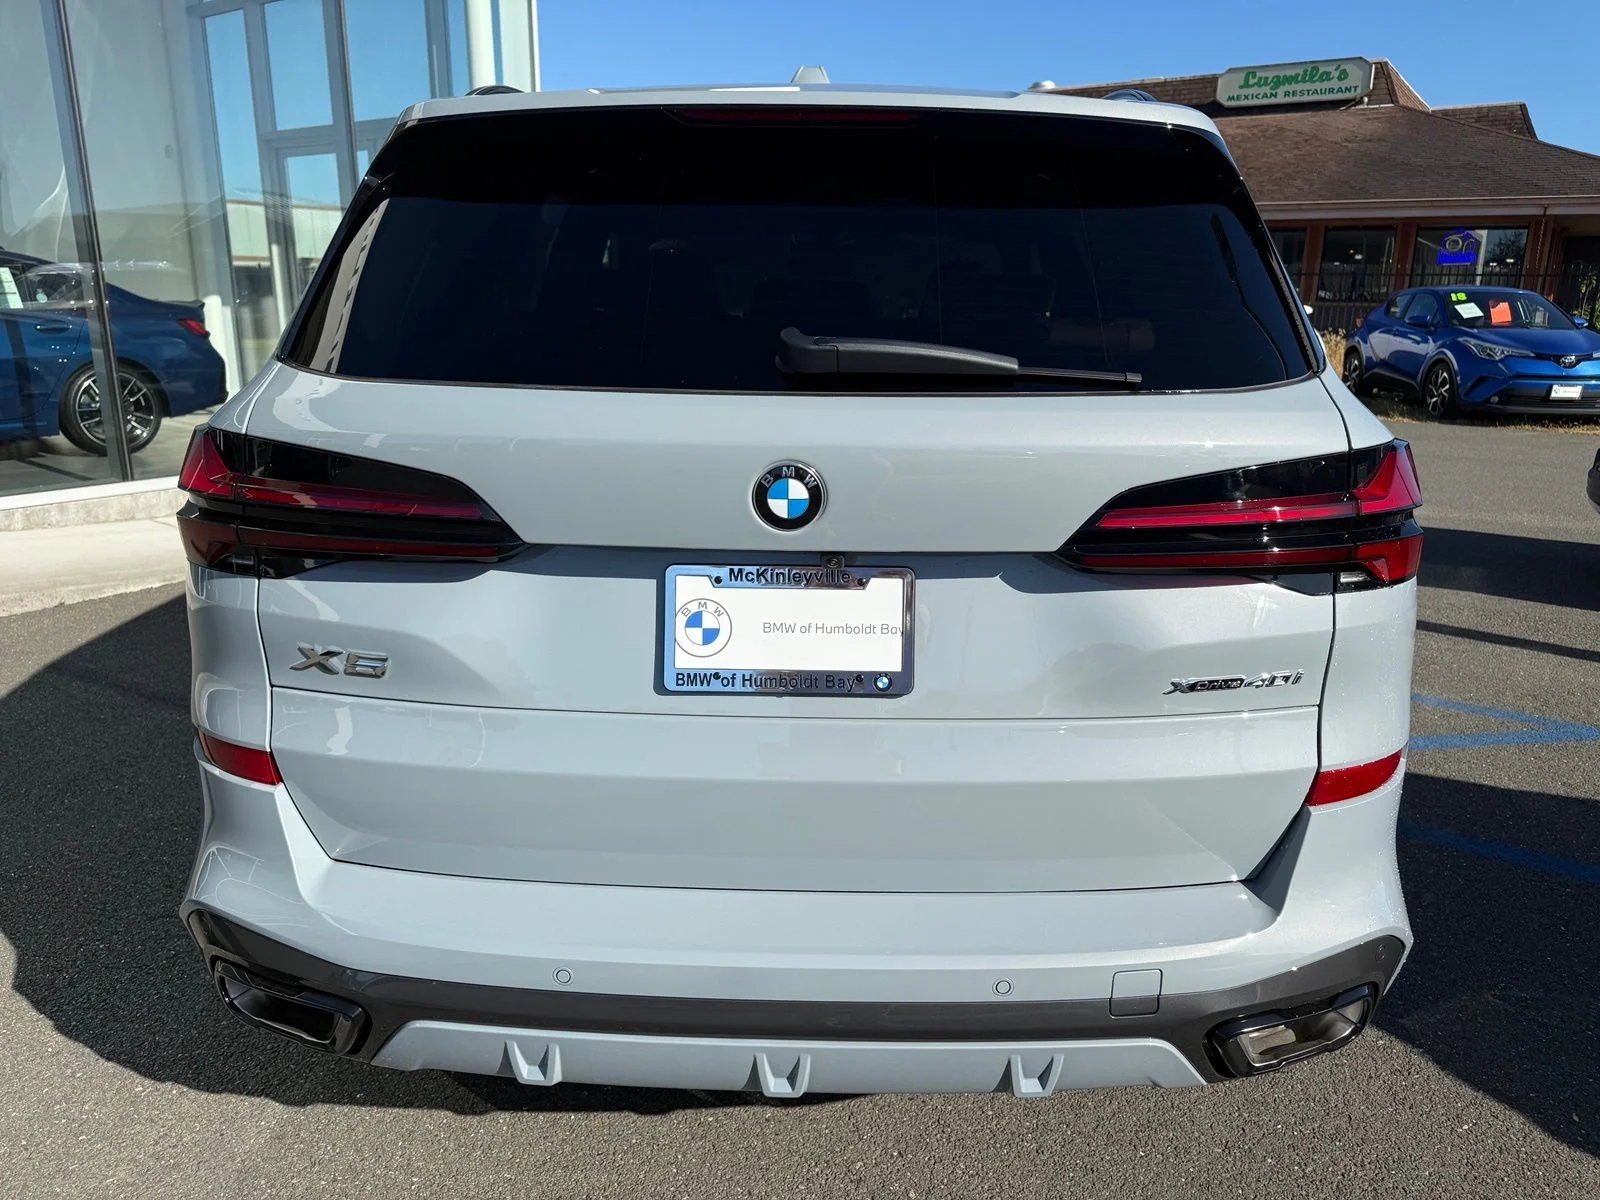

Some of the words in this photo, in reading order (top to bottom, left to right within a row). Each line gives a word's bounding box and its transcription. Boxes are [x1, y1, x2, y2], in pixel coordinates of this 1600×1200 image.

[1238, 64, 1350, 91] Luzmila's
[1226, 91, 1278, 102] MEXICAN
[1283, 85, 1359, 98] RESTAURANT
[760, 466, 817, 488] BMW
[728, 567, 851, 586] McKinleyville
[681, 601, 725, 617] BMW
[762, 621, 797, 634] BMW
[799, 622, 813, 635] of
[815, 622, 877, 635] Humboldt
[675, 672, 714, 687] BMW
[721, 672, 737, 688] of
[741, 673, 819, 689] Humboldt
[824, 674, 856, 692] Bay
